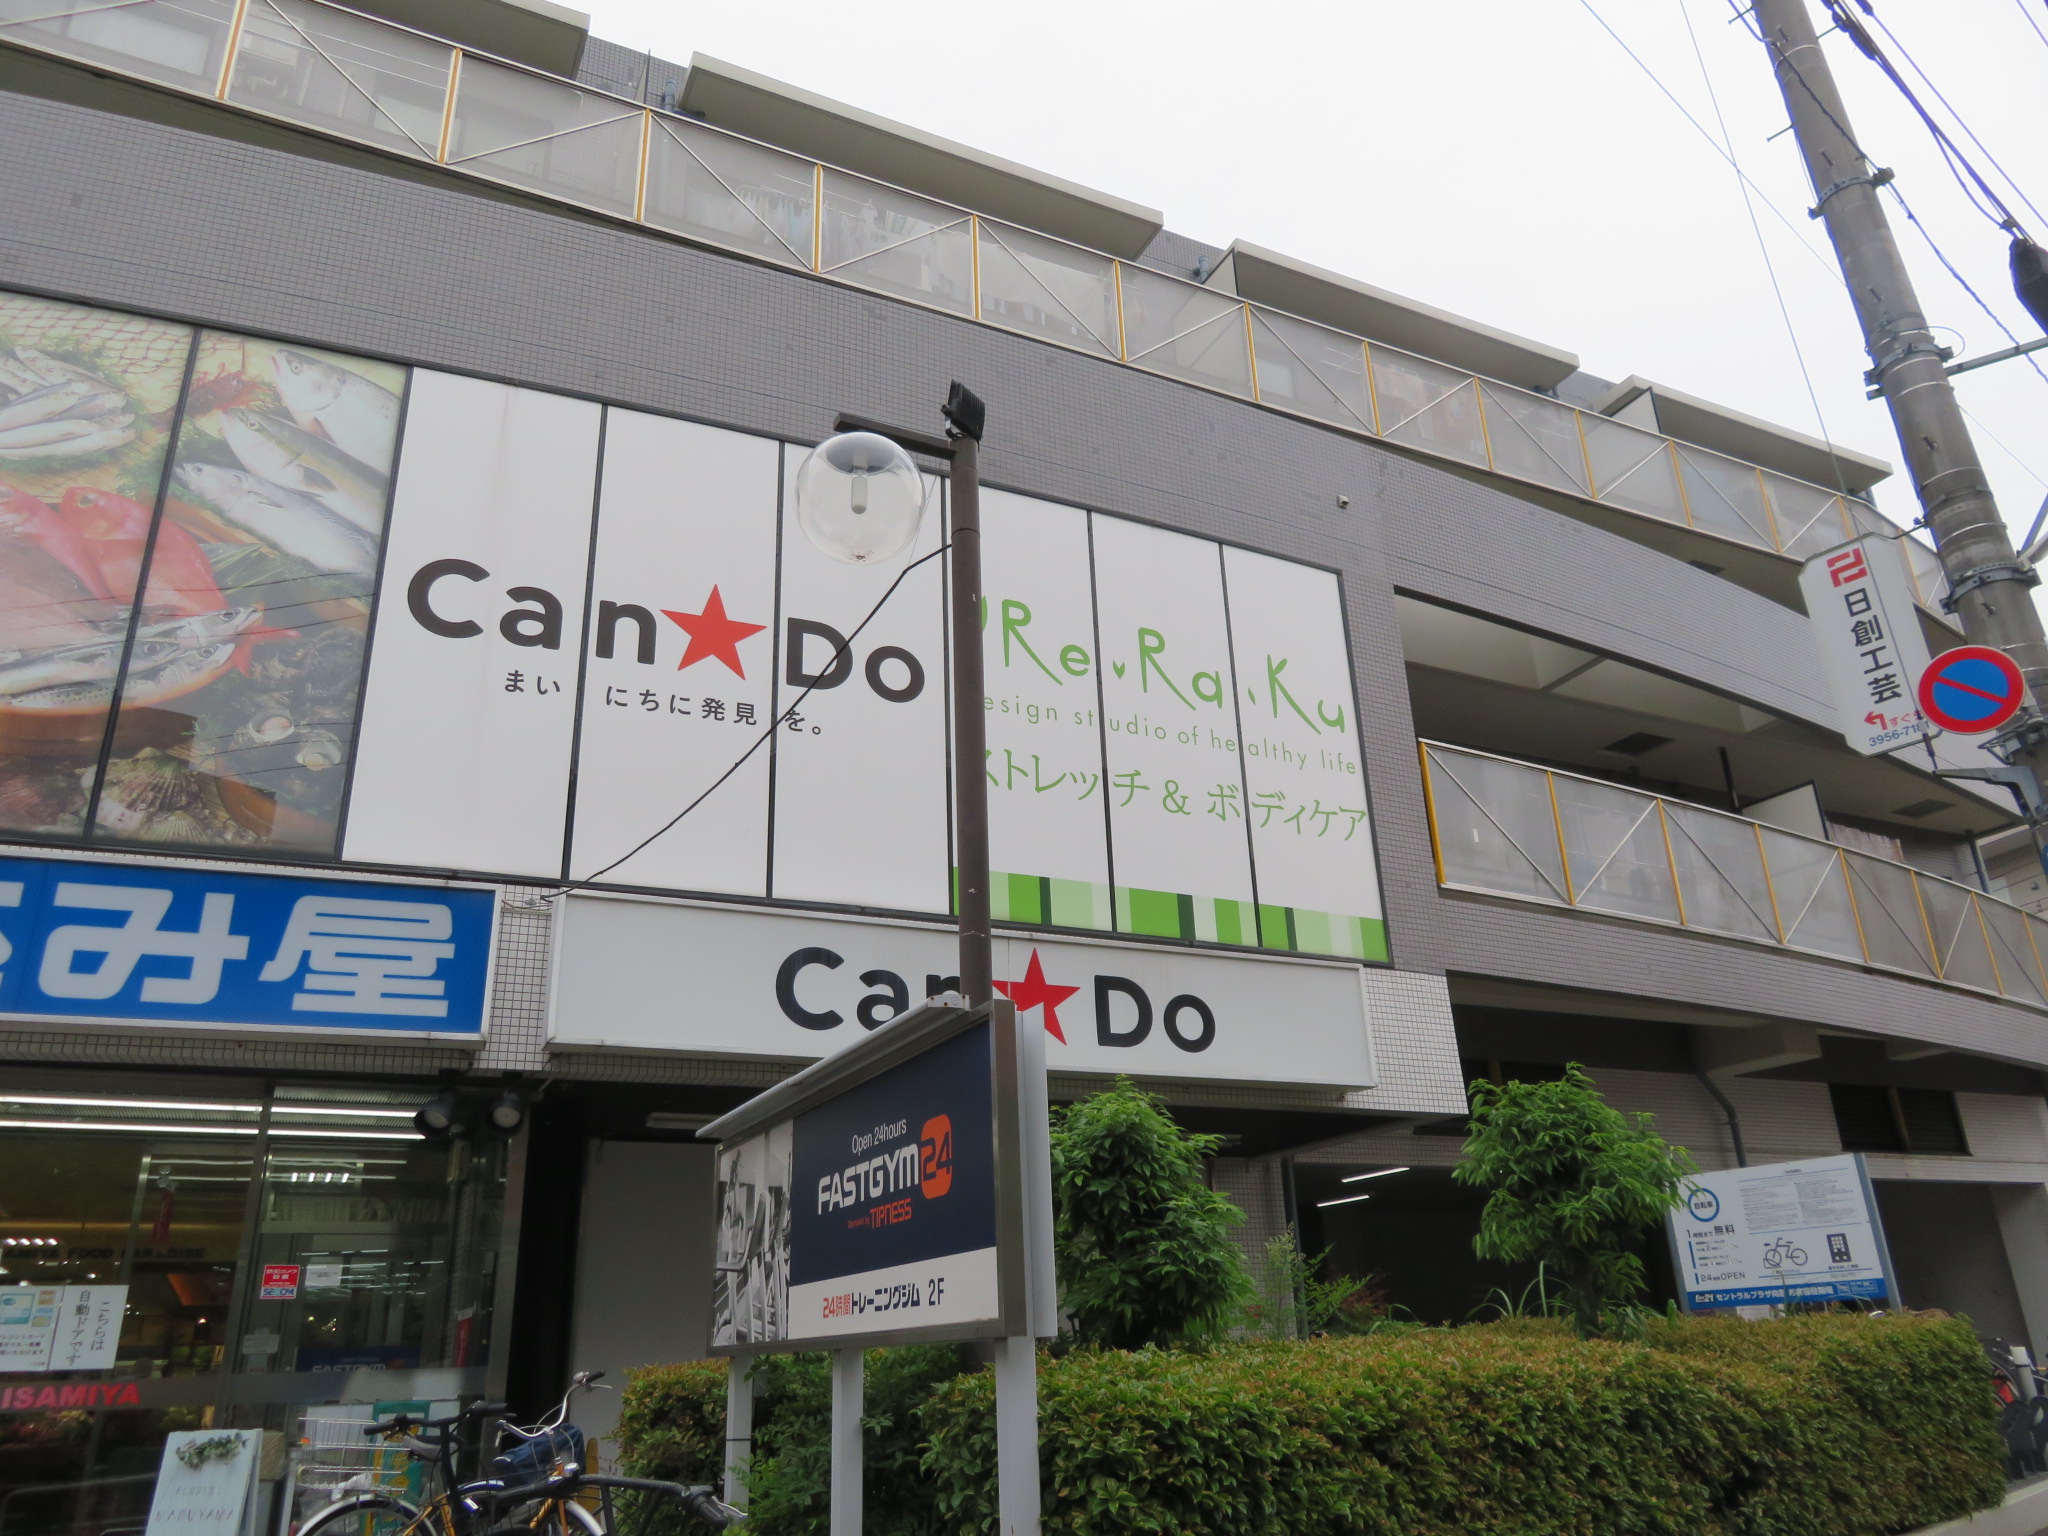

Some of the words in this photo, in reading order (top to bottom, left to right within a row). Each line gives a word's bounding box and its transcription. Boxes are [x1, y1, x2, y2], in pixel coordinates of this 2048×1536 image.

[407, 558, 657, 666] Can
[786, 617, 926, 704] Do
[1844, 587, 1902, 705] 日創工芸
[984, 695, 1058, 724] esign
[1074, 708, 1167, 741] studio
[1178, 725, 1199, 746] of
[1211, 728, 1307, 771] healthy
[1321, 748, 1357, 775] life
[1207, 783, 1367, 842] ボディケア
[775, 946, 960, 1031] Ca
[1094, 974, 1216, 1053] Do
[852, 1133, 873, 1157] Open
[874, 1117, 907, 1144] 24hours
[870, 1197, 912, 1230] TIPNESS
[263, 1288, 295, 1296] SEOM
[928, 1277, 945, 1306] 2F
[65, 1289, 92, 1367] 自動ドアです
[91, 1301, 111, 1351] こちらは
